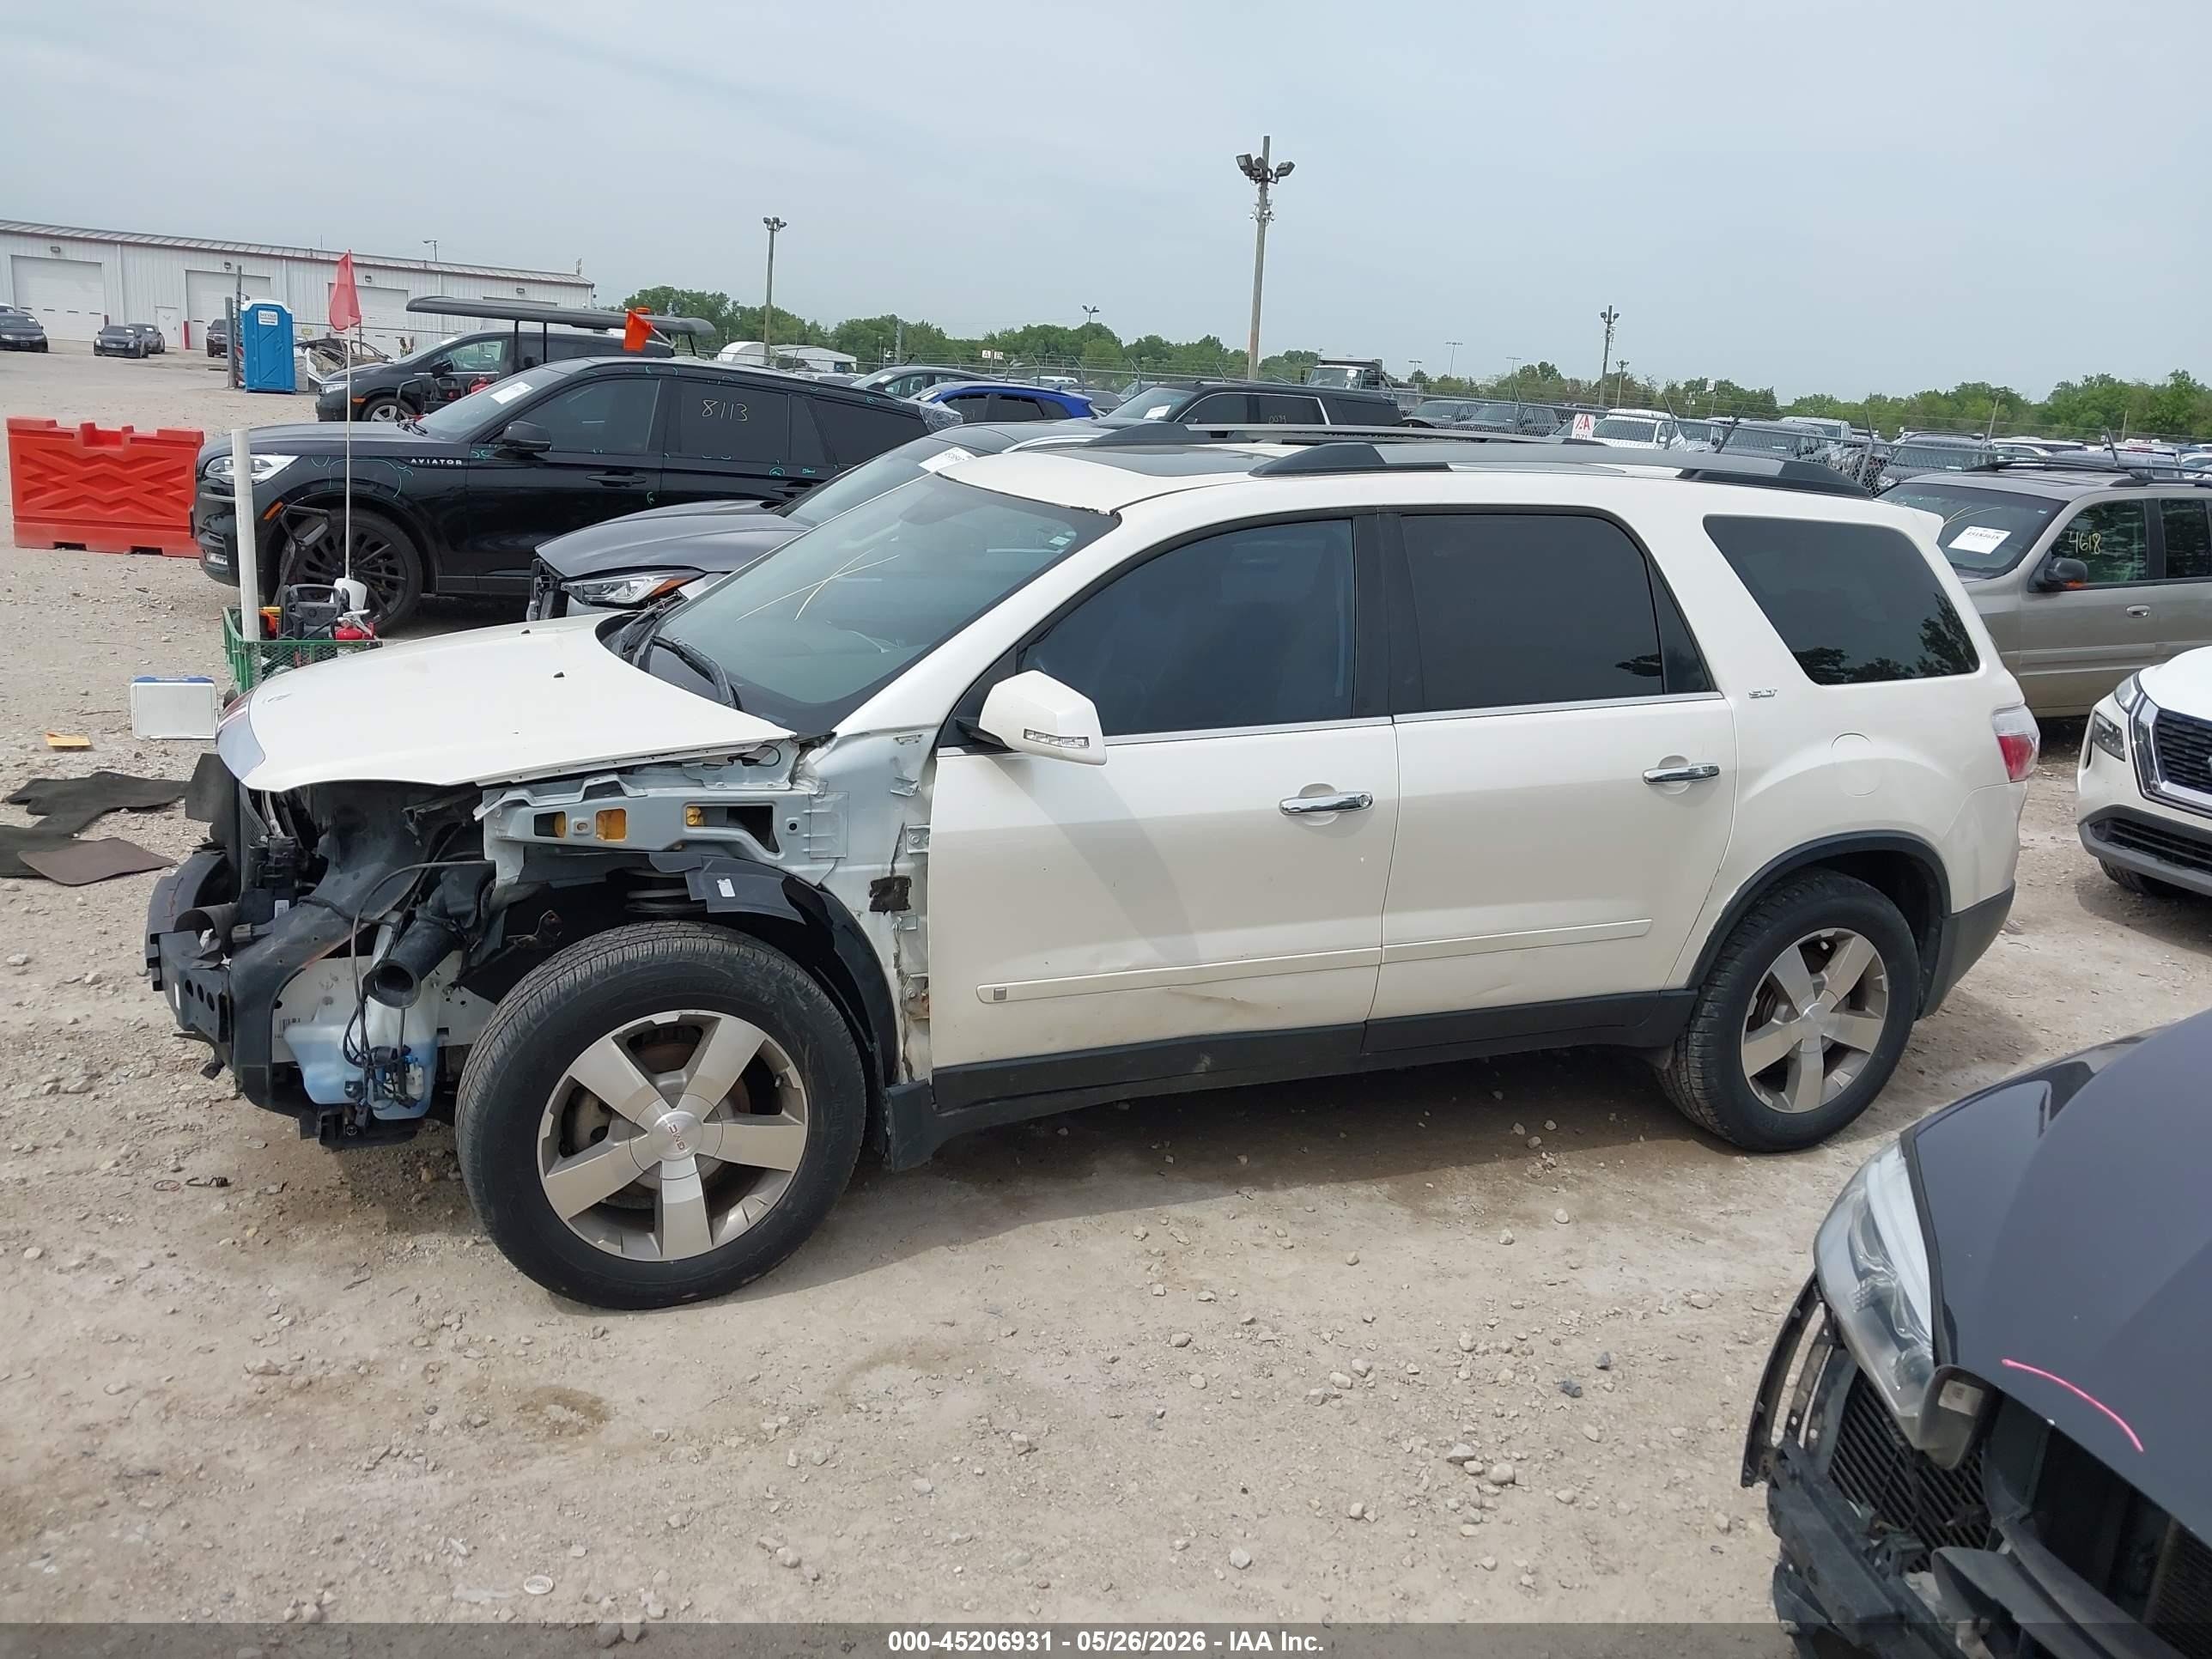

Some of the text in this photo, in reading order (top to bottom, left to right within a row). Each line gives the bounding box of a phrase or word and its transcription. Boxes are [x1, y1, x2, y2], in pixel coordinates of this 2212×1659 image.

[702, 399, 748, 422] 8113
[2067, 531, 2101, 555] 4618
[1747, 689, 1778, 699] SLT
[668, 1124, 686, 1151] GMC
